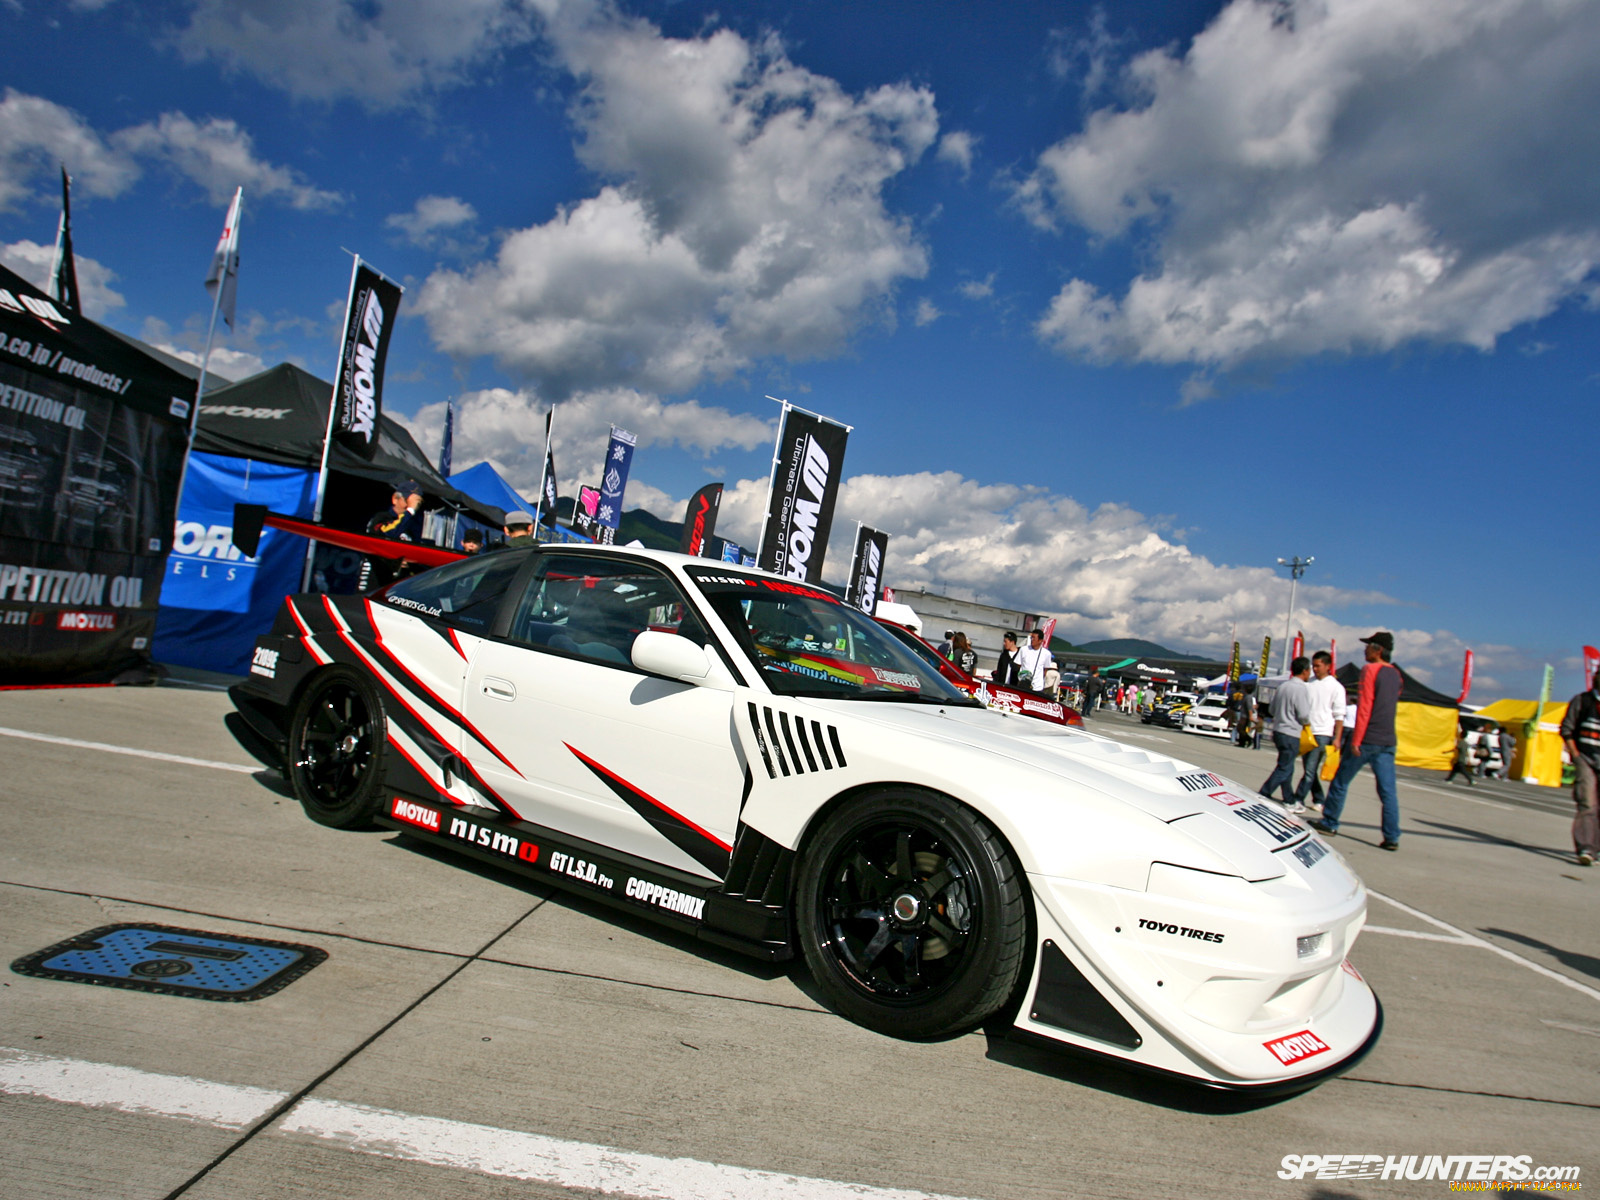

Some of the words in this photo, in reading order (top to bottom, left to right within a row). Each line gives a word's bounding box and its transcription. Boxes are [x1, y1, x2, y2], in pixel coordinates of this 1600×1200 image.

[351, 342, 378, 443] WORK
[63, 405, 87, 430] OIL
[785, 437, 804, 493] Ultimate
[781, 495, 792, 530] Gear
[777, 532, 786, 549] of
[109, 575, 143, 608] OIL
[696, 575, 759, 588] nismo
[60, 611, 115, 629] MOTUL
[1175, 772, 1225, 793] nismo
[394, 799, 438, 829] MOTUL
[449, 817, 540, 864] nismo
[549, 851, 568, 872] GT
[597, 873, 614, 889] Pro
[625, 876, 706, 920] COPPERMIX
[1138, 918, 1179, 935] TOYO
[1179, 926, 1225, 944] TIRES
[1270, 1032, 1327, 1063] MOTUL
